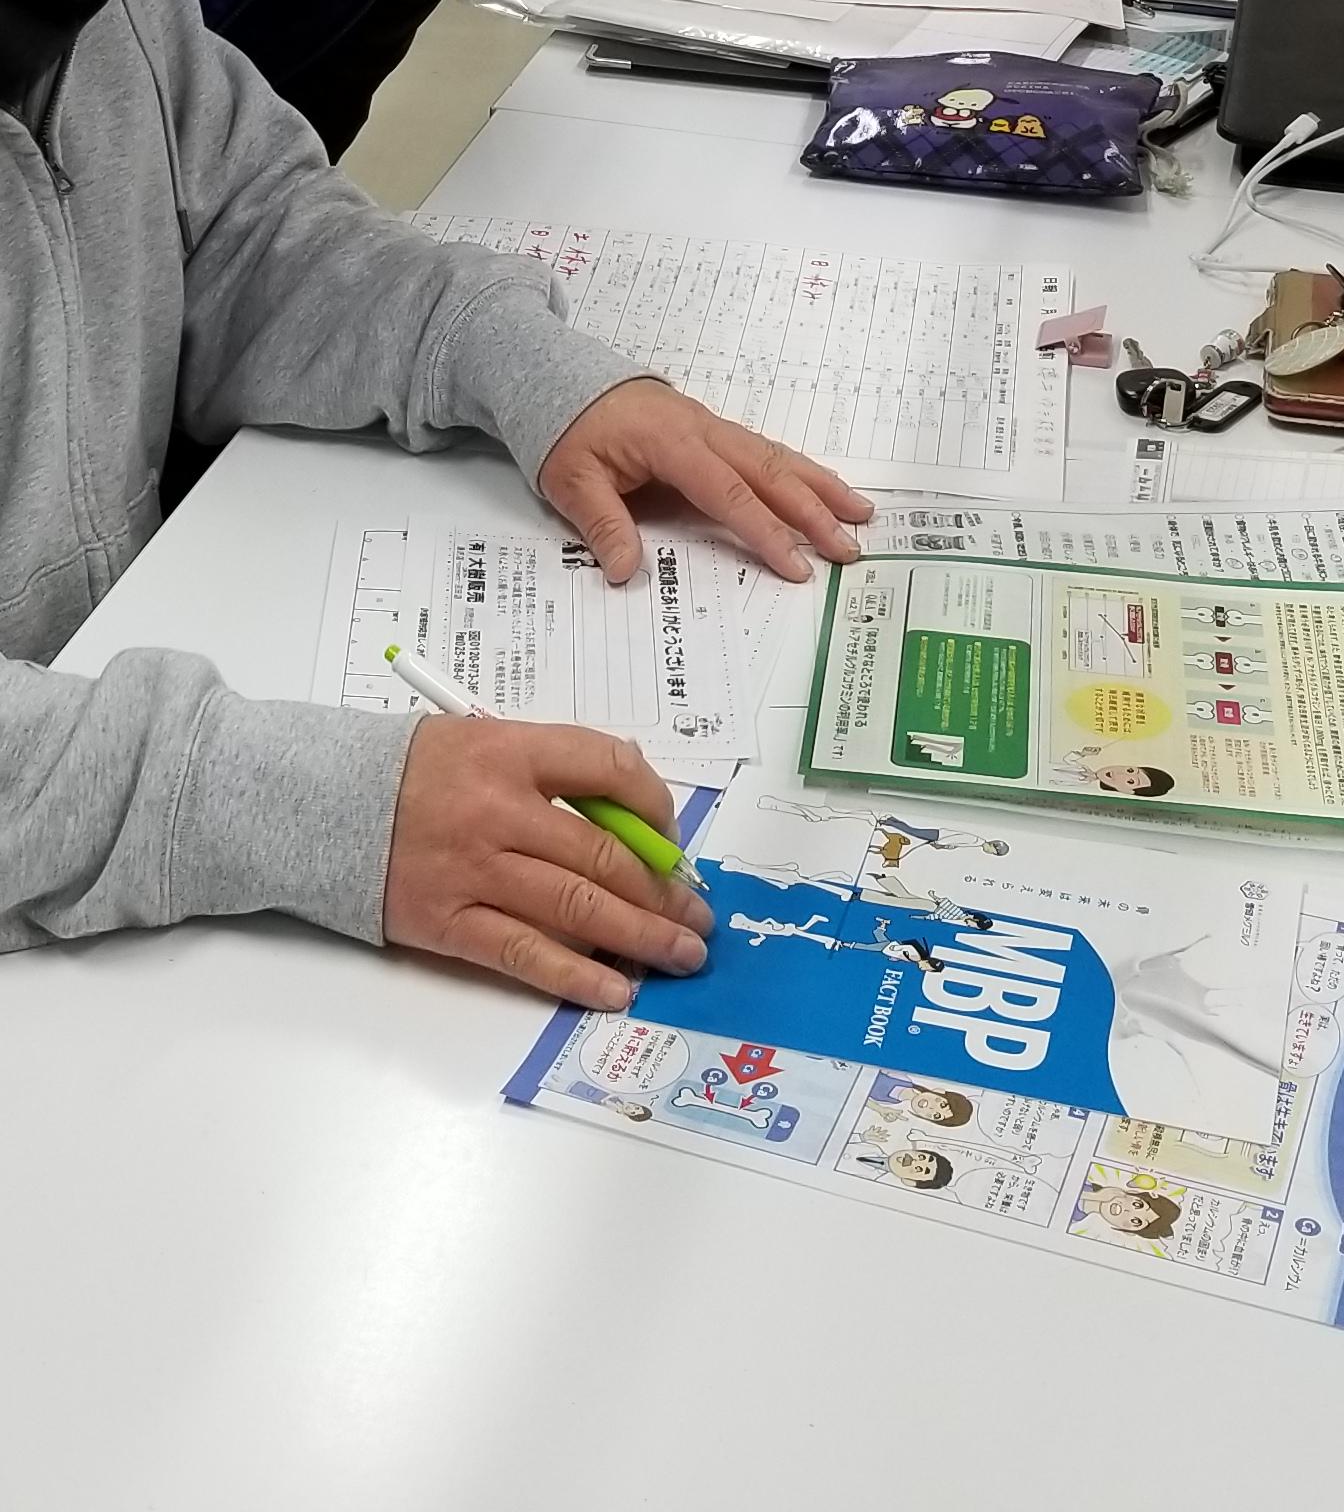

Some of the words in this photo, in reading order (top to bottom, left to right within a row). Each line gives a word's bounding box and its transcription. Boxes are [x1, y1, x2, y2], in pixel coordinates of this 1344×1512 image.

[725, 298, 772, 319] 大樹販売
[656, 545, 690, 708] ご愛飲頂きありがとうございます!
[875, 968, 904, 1008] FACT
[911, 927, 1074, 1071] MBP
[862, 1005, 894, 1048] BOOK
[1287, 1010, 1314, 1071] 生きていますよ!
[1194, 1197, 1222, 1262] カルシウムの固まり
